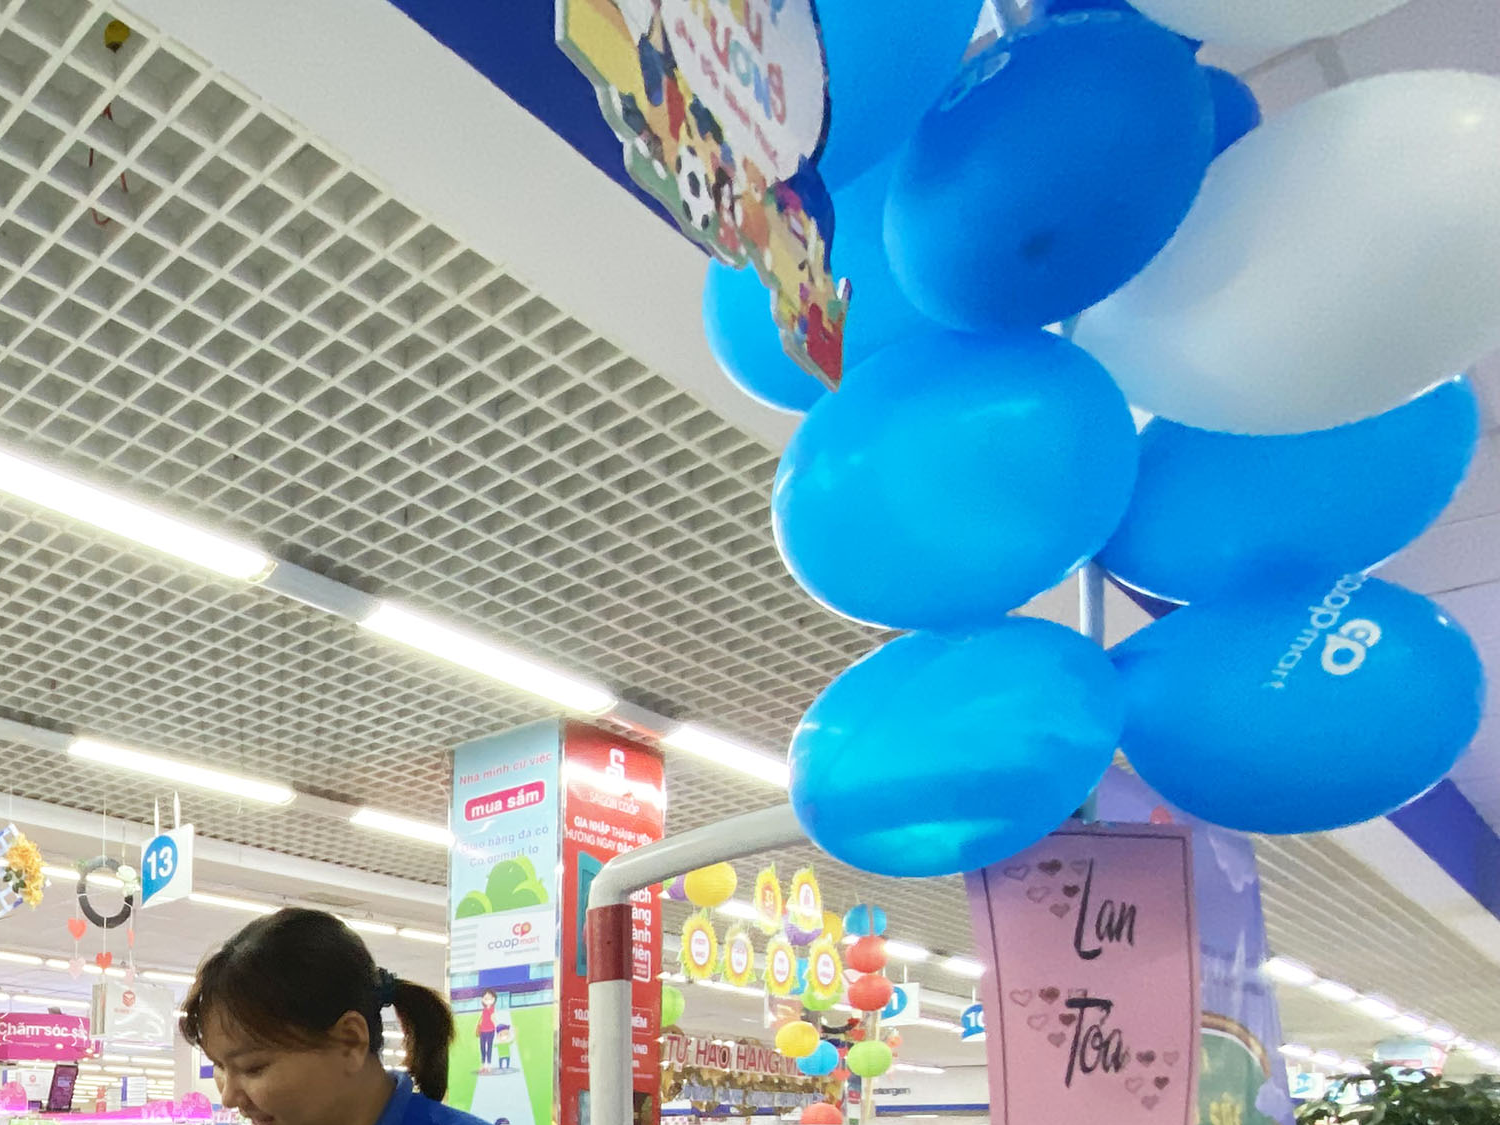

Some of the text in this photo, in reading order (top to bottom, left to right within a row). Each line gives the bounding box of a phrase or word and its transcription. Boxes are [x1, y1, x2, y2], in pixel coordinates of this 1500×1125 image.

[471, 799, 503, 818] mua
[146, 845, 174, 881] 13
[1073, 857, 1138, 961] Lan
